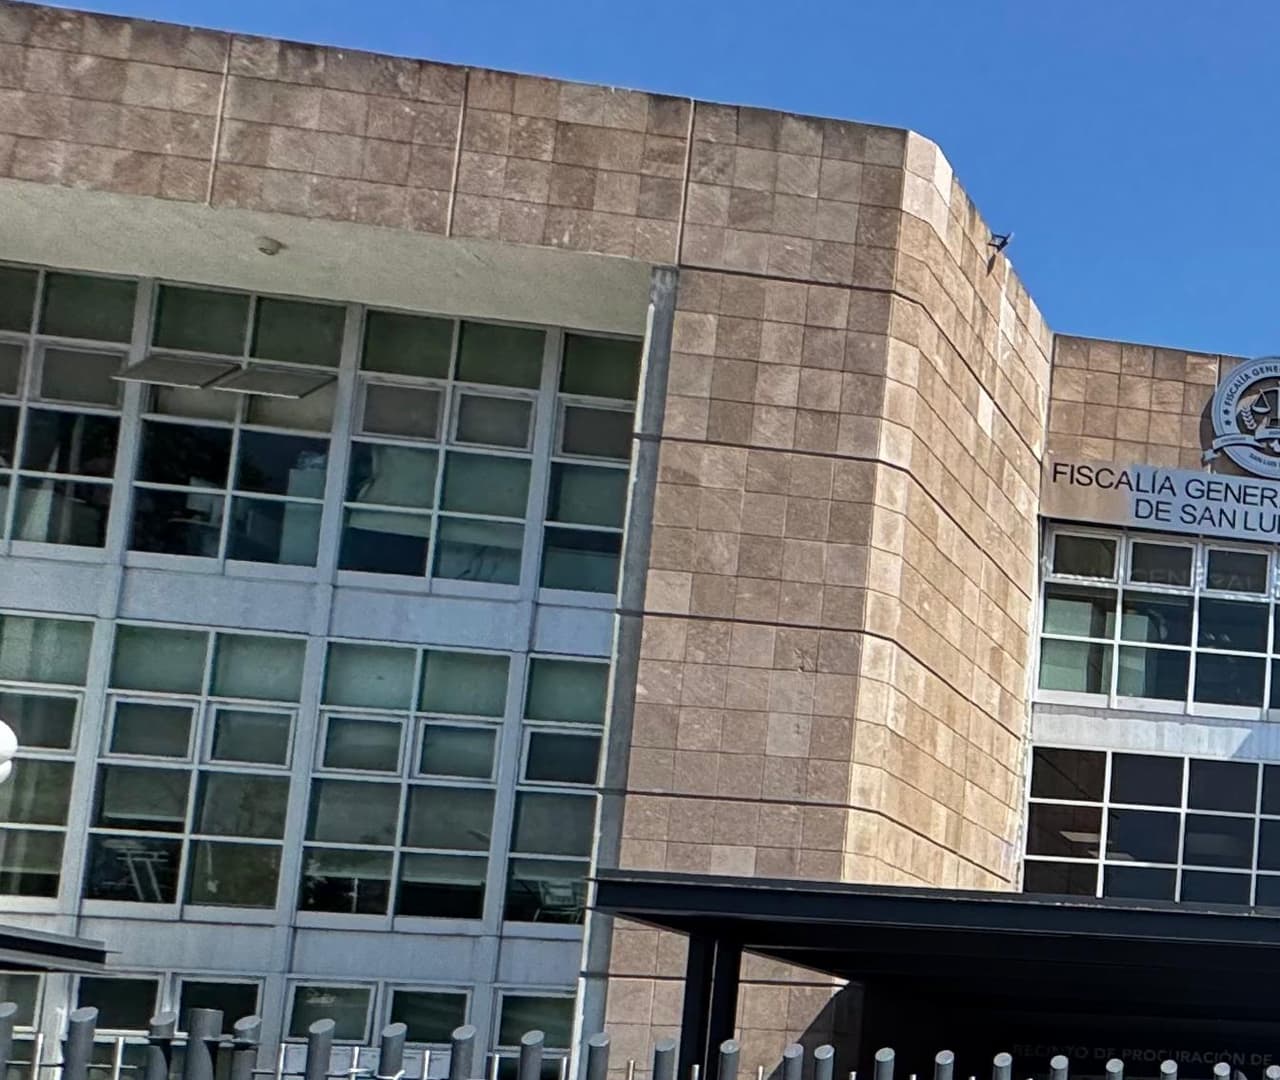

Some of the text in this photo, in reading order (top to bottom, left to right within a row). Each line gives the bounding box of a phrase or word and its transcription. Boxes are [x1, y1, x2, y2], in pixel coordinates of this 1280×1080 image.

[1052, 461, 1176, 497] FISCALÍA
[1134, 500, 1172, 522] DE
[1179, 506, 1236, 536] SAN
[1250, 1053, 1273, 1066] DE
